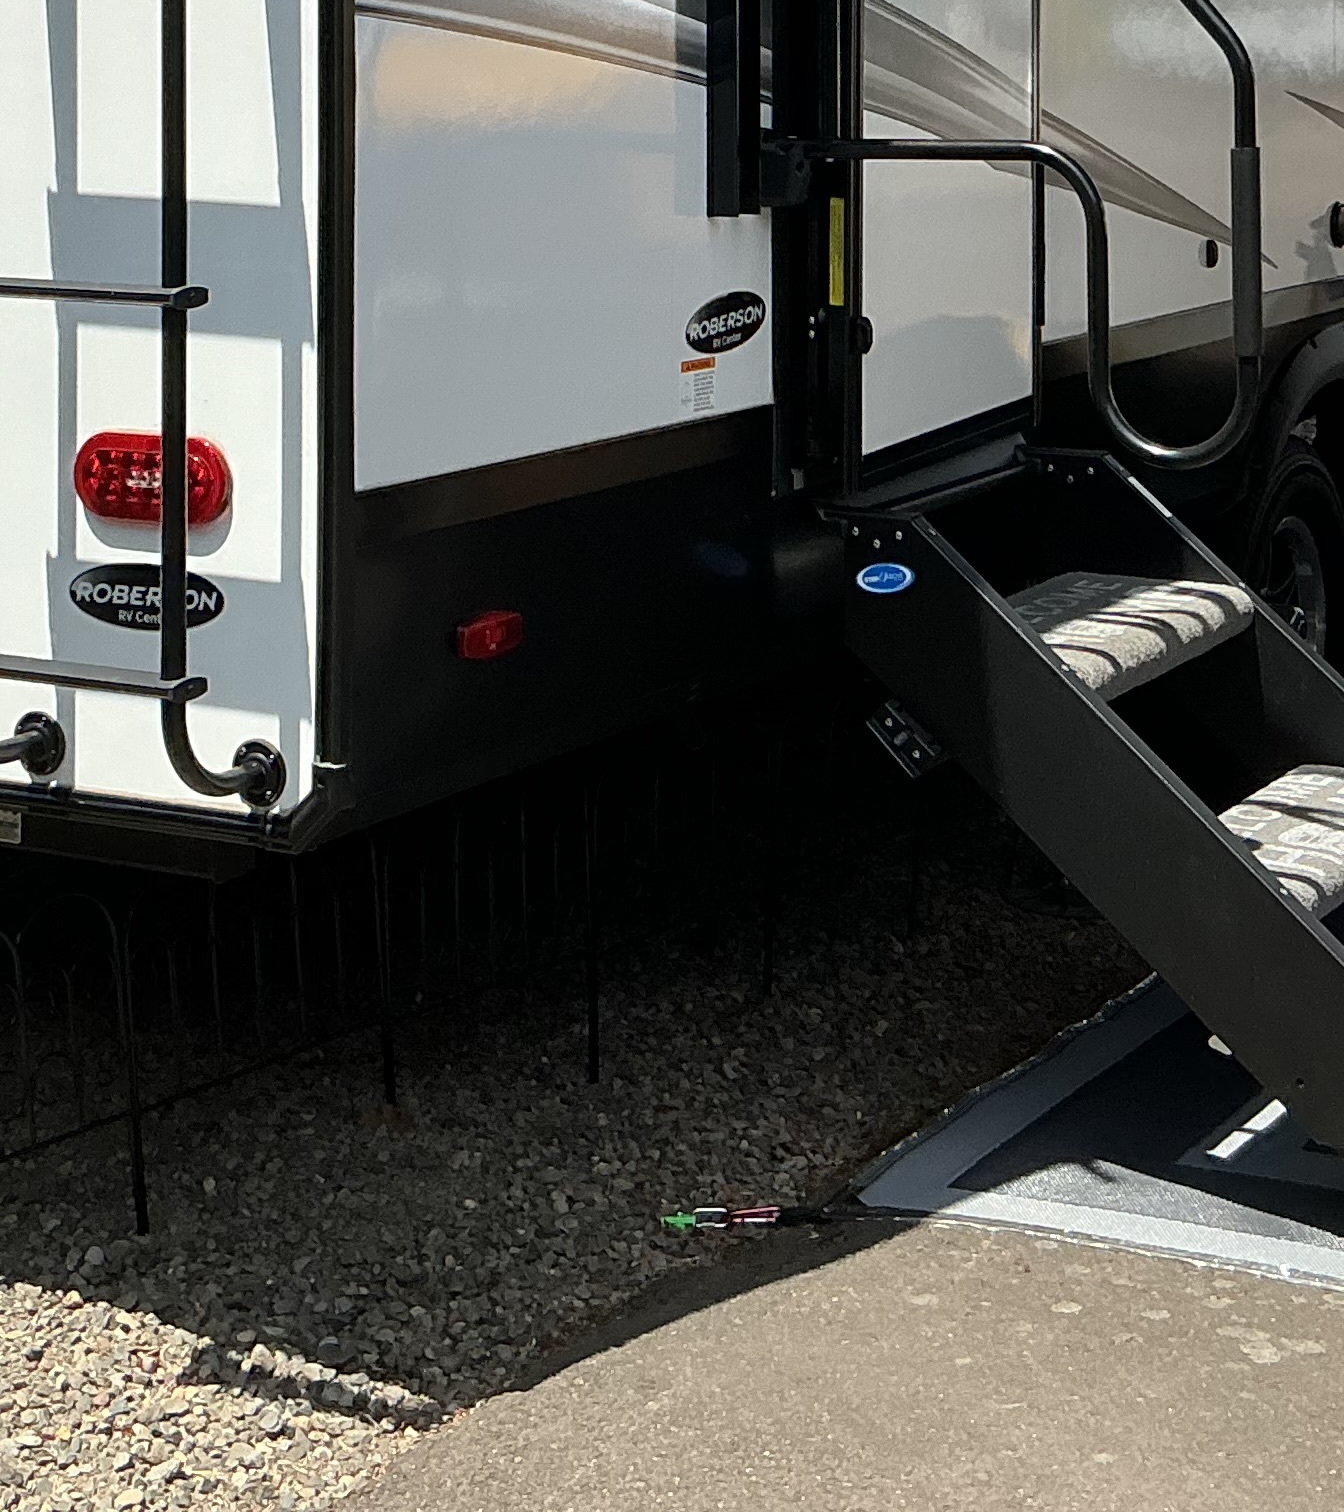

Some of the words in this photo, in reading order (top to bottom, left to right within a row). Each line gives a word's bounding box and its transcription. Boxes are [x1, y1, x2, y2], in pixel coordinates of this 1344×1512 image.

[687, 302, 763, 342] ROBERSON
[75, 581, 218, 613] ROBERON
[118, 609, 134, 623] RV
[135, 610, 162, 624] Cent
